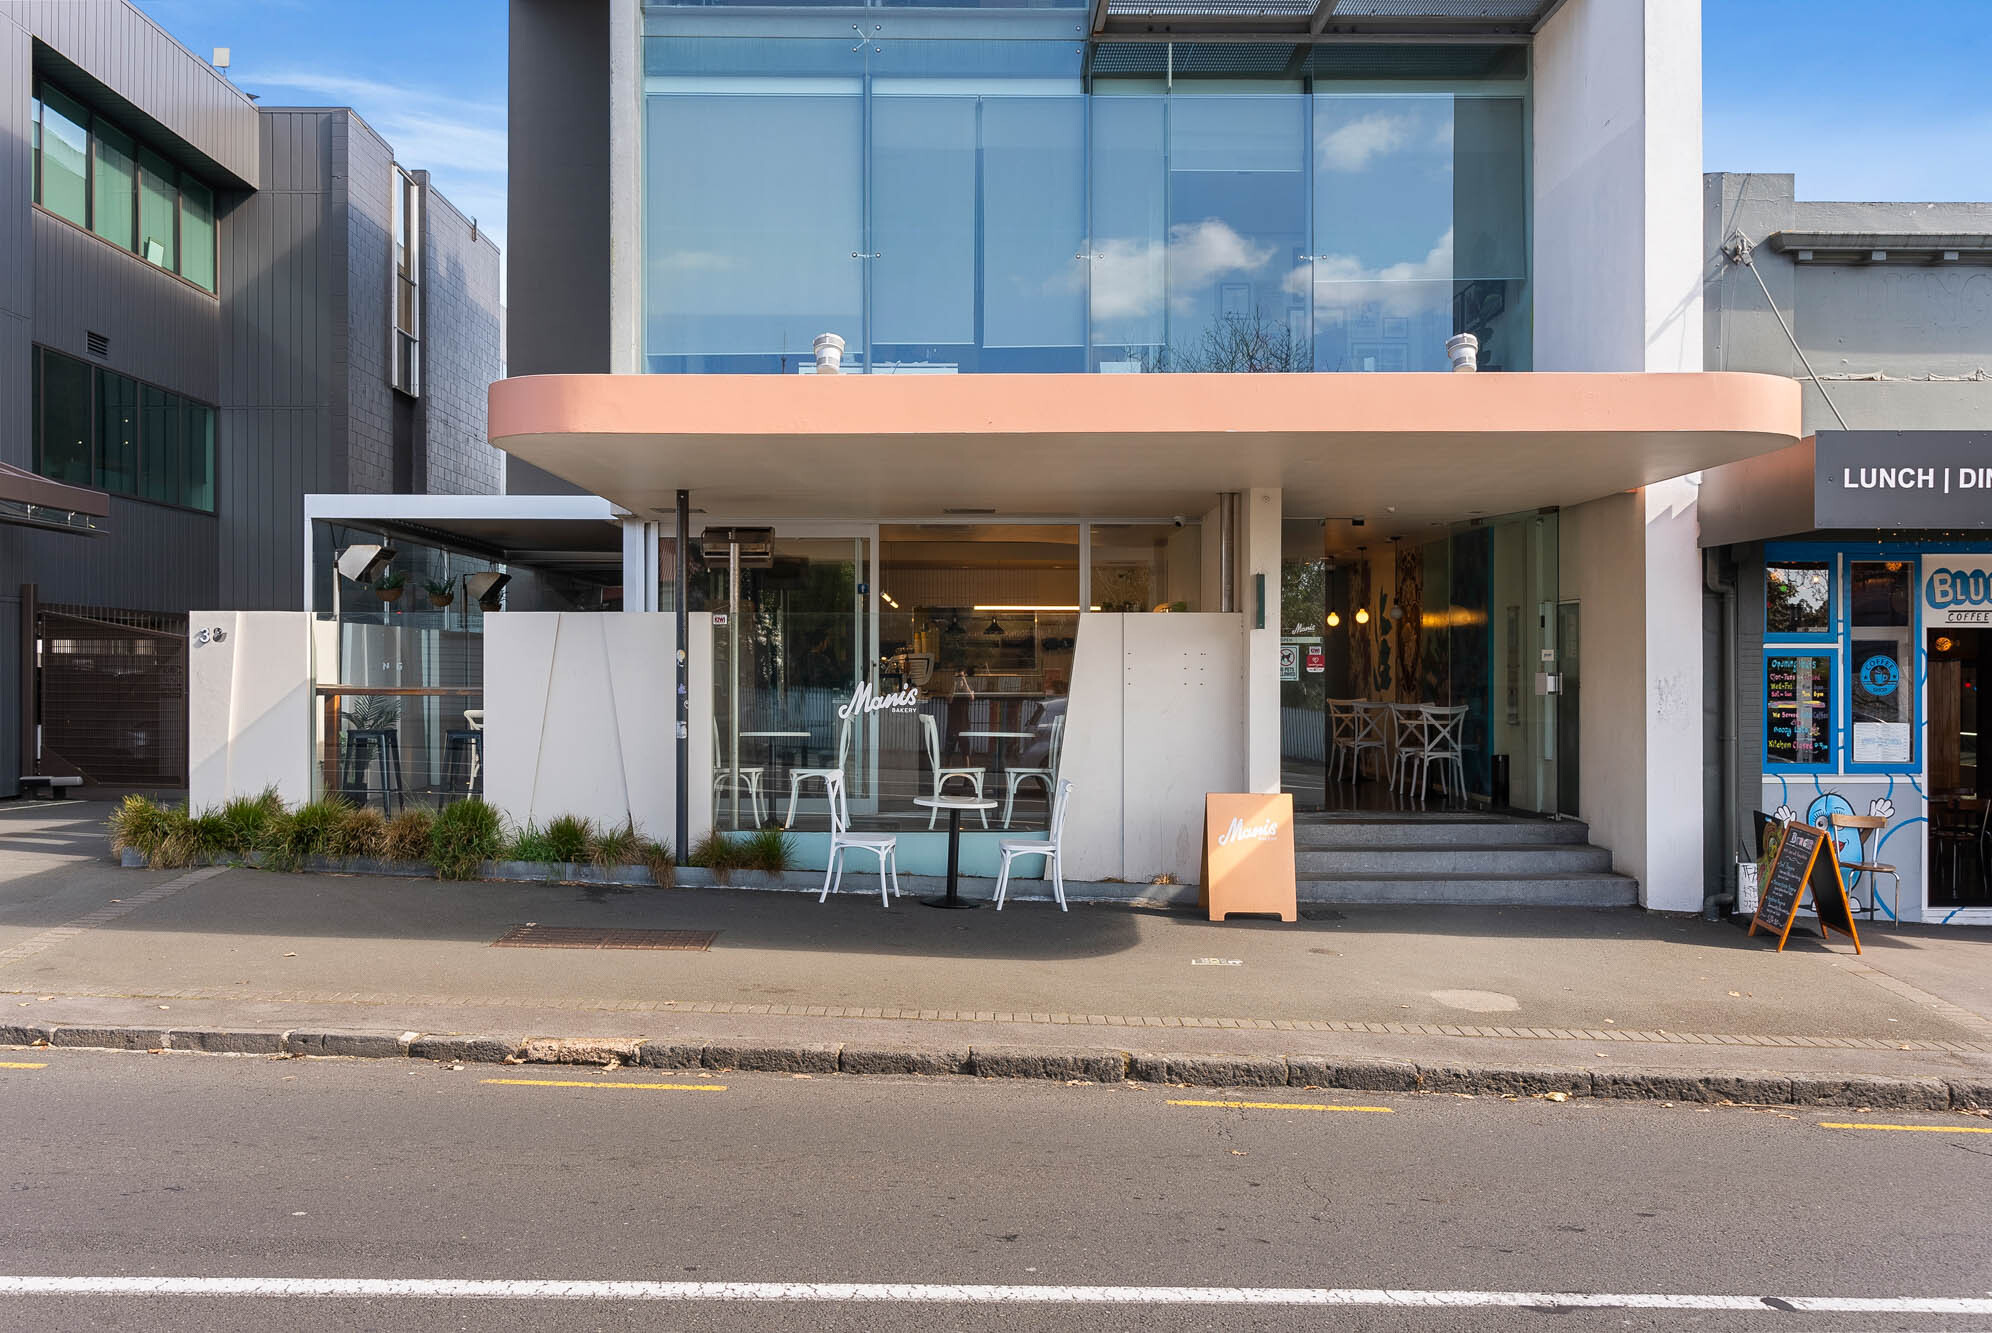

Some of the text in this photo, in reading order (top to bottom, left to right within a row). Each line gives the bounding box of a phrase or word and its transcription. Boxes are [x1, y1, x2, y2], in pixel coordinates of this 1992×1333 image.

[1843, 467, 1935, 489] LUNCH
[1932, 572, 1992, 603] BLU
[1947, 612, 1990, 622] COFFEE
[1865, 658, 1895, 671] COFFEE
[838, 680, 919, 720] Manis
[1218, 816, 1278, 846] Manis
